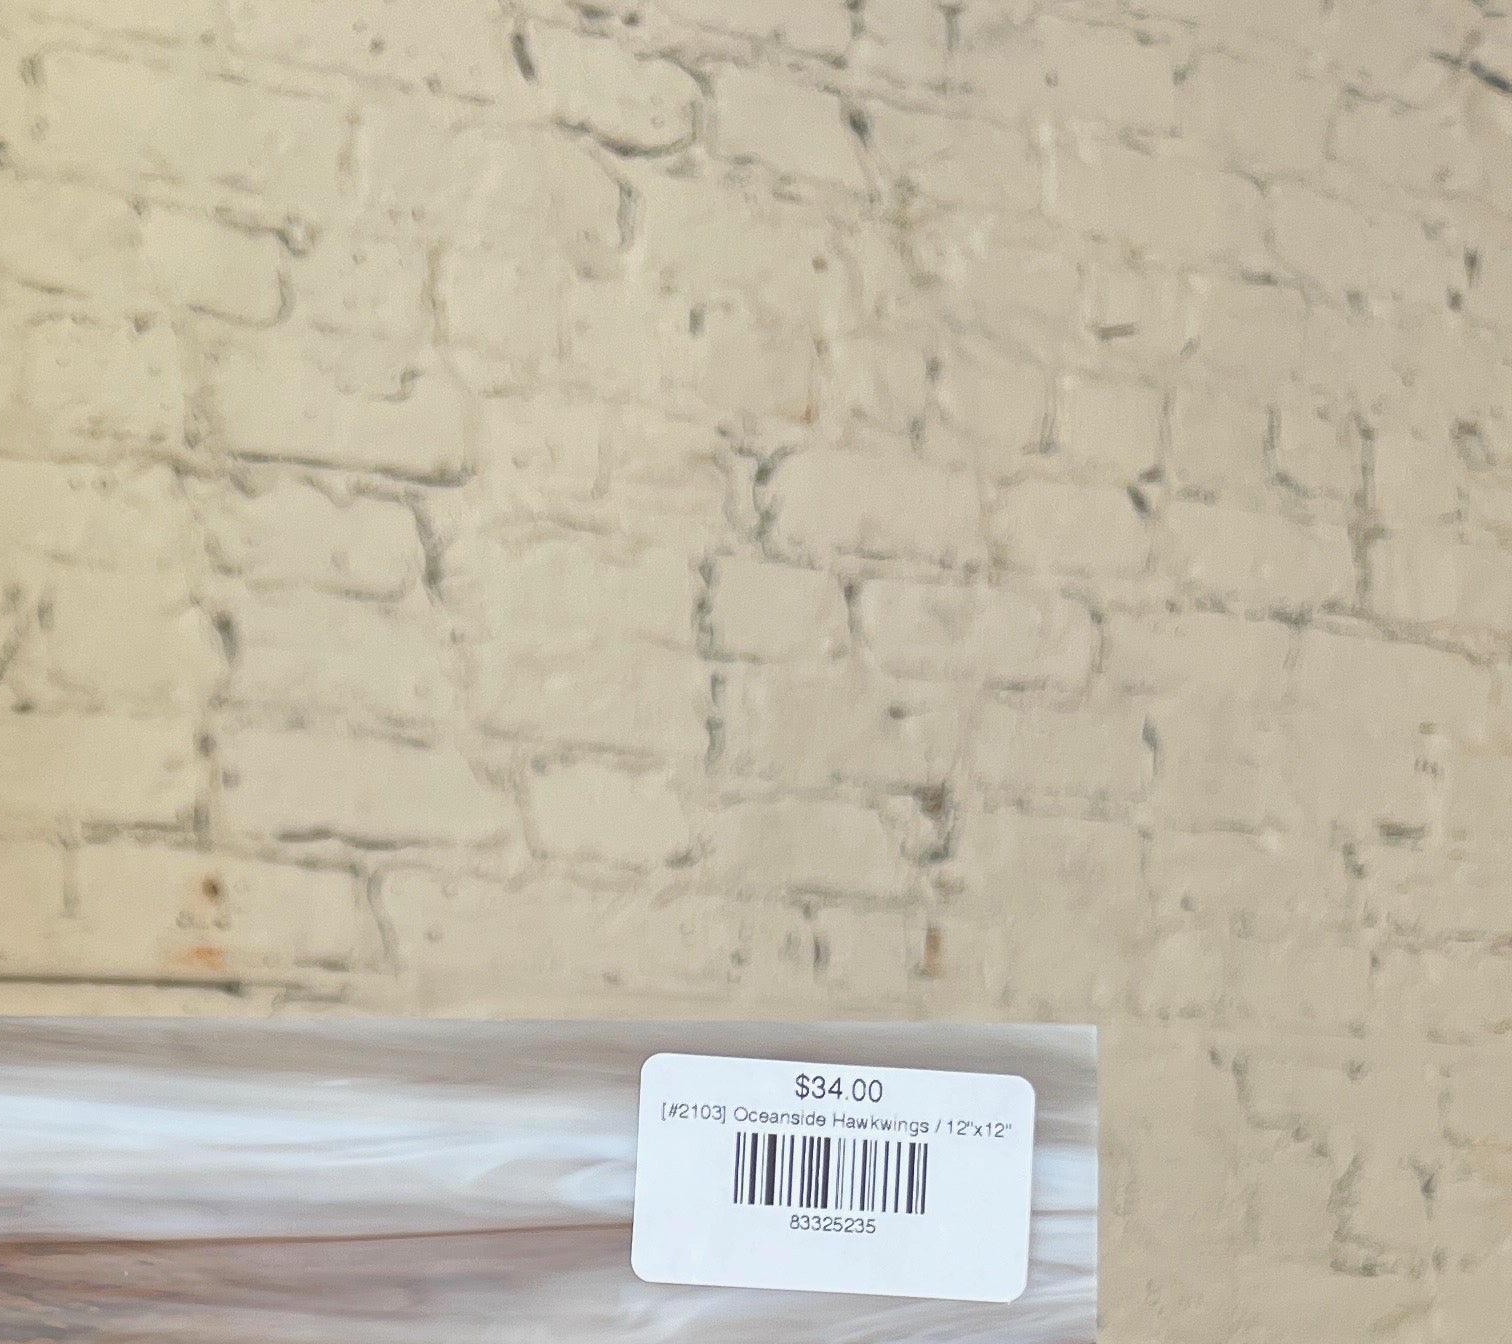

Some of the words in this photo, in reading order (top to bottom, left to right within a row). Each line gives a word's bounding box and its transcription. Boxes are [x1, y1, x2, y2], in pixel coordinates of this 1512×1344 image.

[795, 1073, 883, 1103] $34.00
[661, 1102, 727, 1125] [#2103]
[733, 1106, 827, 1127] Oceanside
[832, 1113, 930, 1137] Hawkwings
[947, 1120, 1013, 1138] 12"x12"
[789, 1214, 876, 1234] 83325235
